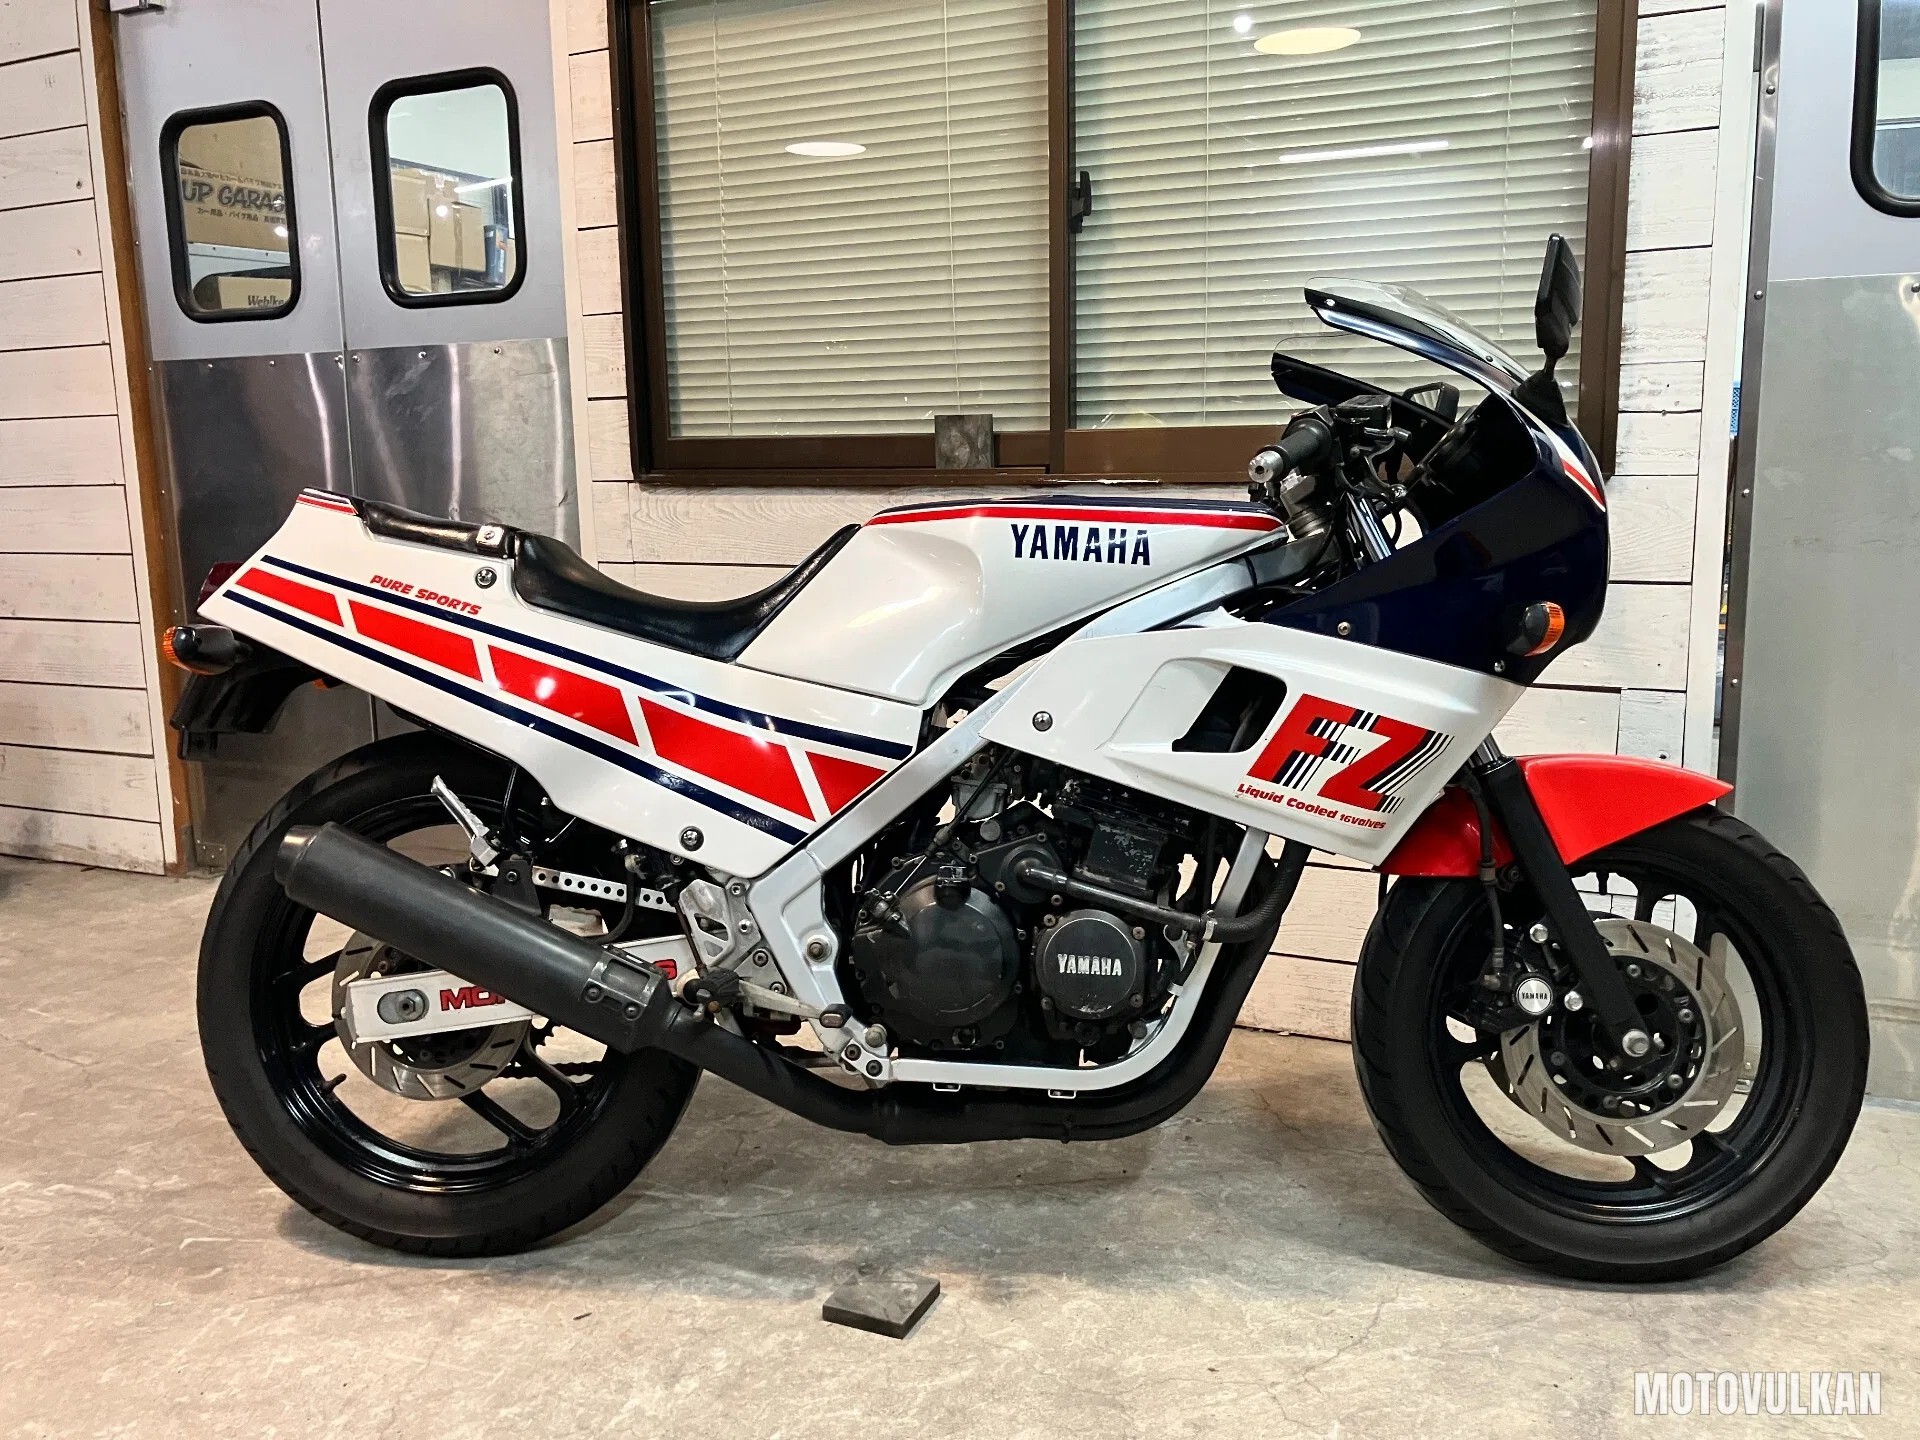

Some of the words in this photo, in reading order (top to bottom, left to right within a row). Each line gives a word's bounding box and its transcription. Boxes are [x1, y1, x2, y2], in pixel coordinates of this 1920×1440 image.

[181, 180, 214, 203] UP
[218, 185, 286, 213] GARAG
[1010, 523, 1151, 566] YAMAHA
[370, 575, 414, 594] PURE
[416, 588, 482, 615] SPORTS
[1247, 693, 1455, 814] FZ
[1237, 783, 1285, 804] Liquid
[1286, 797, 1338, 819] Cooled
[1057, 953, 1122, 976] YAMAHA
[1521, 991, 1548, 1000] YAMAHA
